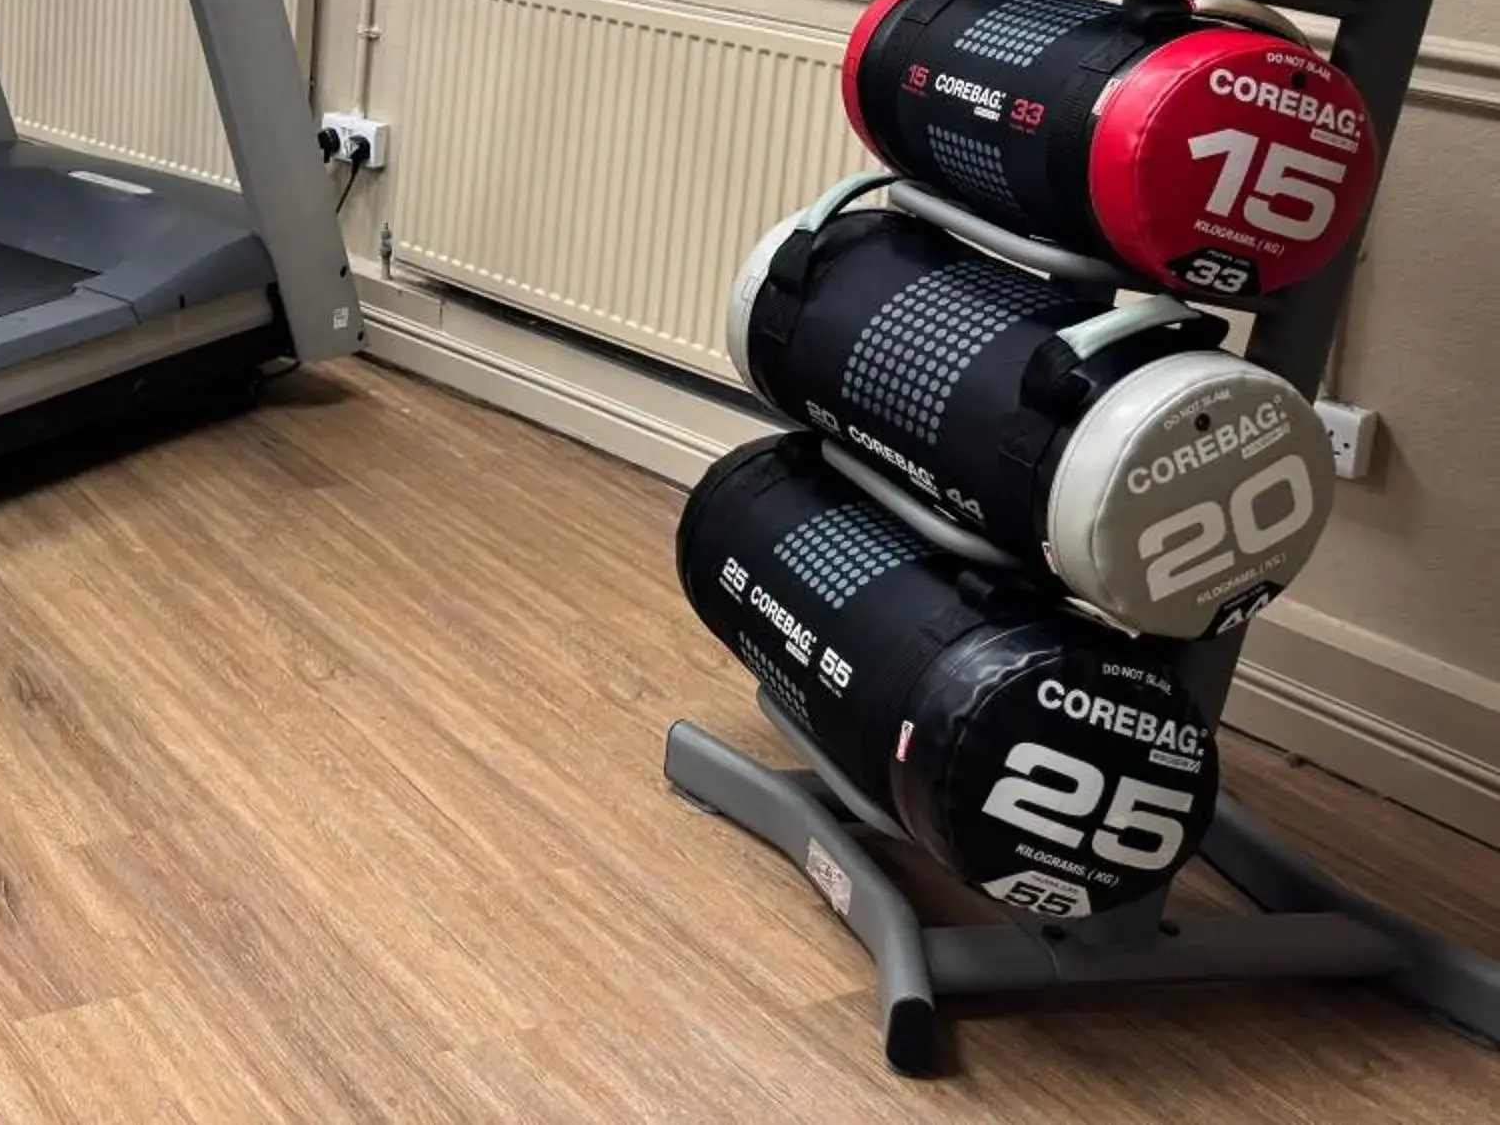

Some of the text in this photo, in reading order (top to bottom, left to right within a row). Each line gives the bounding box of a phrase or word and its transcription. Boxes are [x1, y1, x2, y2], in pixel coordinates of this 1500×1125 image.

[1266, 51, 1283, 65] DO
[1284, 55, 1304, 69] NOT
[908, 63, 930, 89] 15
[1010, 98, 1046, 126] 33
[1188, 128, 1347, 242] 15
[1185, 258, 1248, 293] 33
[1137, 454, 1313, 602] 20
[721, 557, 749, 591] 25
[819, 646, 853, 689] 55
[1102, 663, 1120, 676] DO
[1121, 667, 1144, 682] NOT
[981, 741, 1194, 870] 25
[1015, 842, 1085, 875] KILOGRAMS
[1005, 881, 1077, 915] 55
